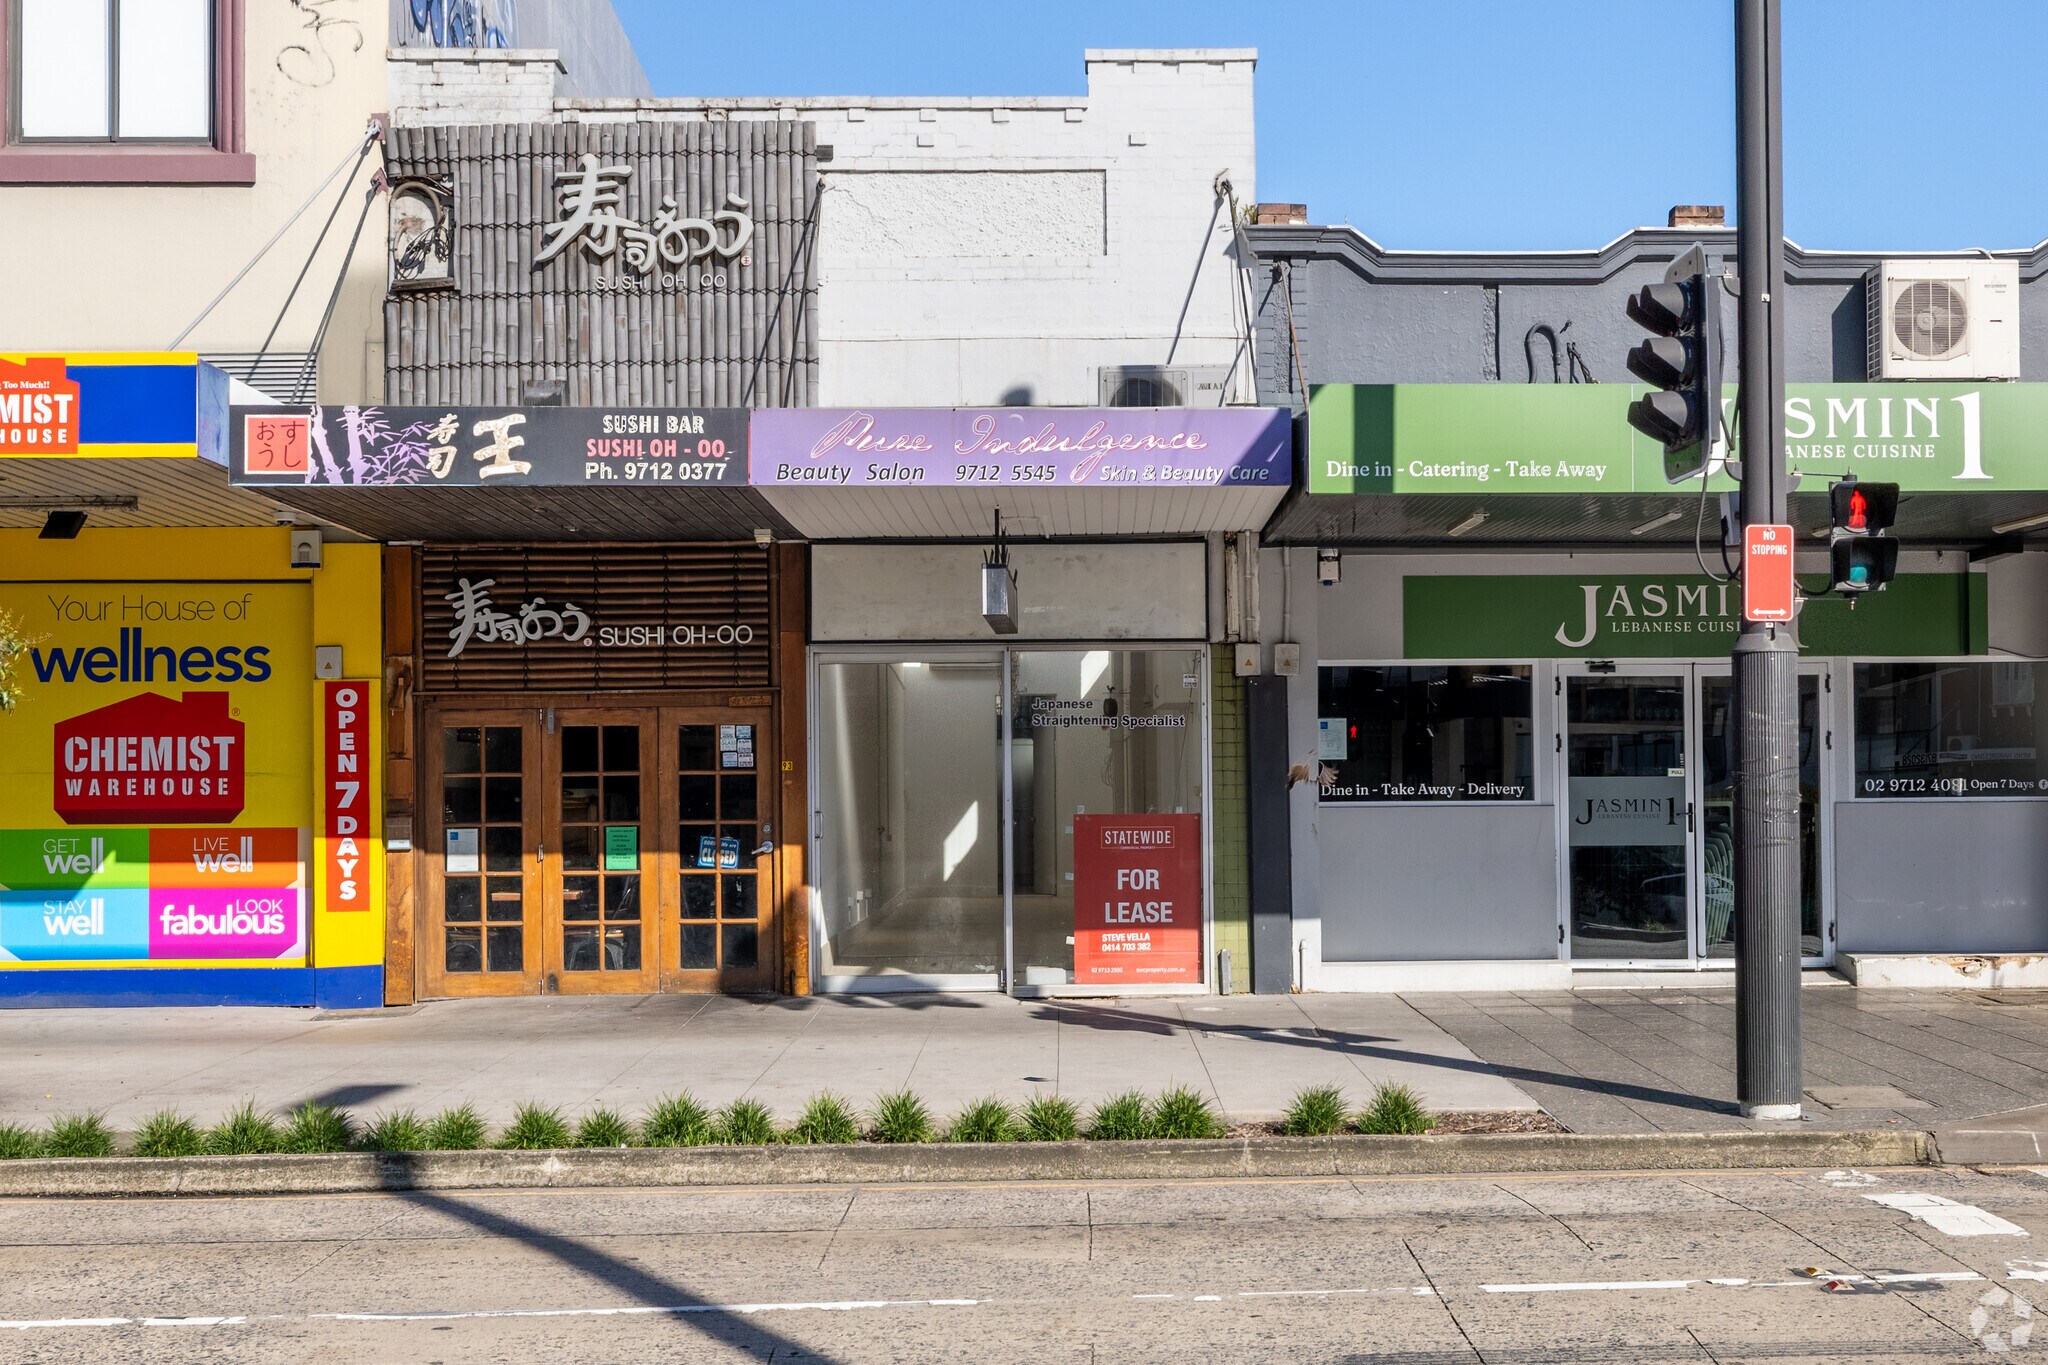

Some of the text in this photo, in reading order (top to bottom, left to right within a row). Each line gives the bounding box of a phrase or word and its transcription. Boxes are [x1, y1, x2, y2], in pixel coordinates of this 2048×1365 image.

[594, 275, 647, 290] SUSHI
[661, 274, 686, 288] OH
[3, 381, 18, 389] Too
[20, 381, 50, 389] Much!!
[602, 414, 704, 434] SUSHI BAR
[586, 439, 643, 457] SUSHI
[650, 439, 677, 457] OH
[810, 410, 1208, 484] Pure Indulgence
[1785, 444, 1935, 459] ANESE CUISINE
[585, 462, 727, 480] Ph. 9712 0377
[776, 462, 1269, 485] Beauty Salon 9712 5545 Skin & Beauty Care
[1326, 461, 1370, 478] Dine
[1374, 461, 1392, 477] in
[1409, 460, 1490, 481] Catering
[1505, 460, 1552, 478] Take
[1556, 460, 1607, 481] Away
[1762, 530, 1776, 541] NO
[1752, 544, 1788, 555] STOPPING
[47, 592, 253, 621] Your House of
[1554, 584, 1742, 648] JASMI
[599, 626, 664, 646] SUSHI
[672, 625, 753, 645] OH-OO
[1612, 621, 1741, 633] LEBANESE CUISI
[31, 627, 272, 682] wellness
[1032, 698, 1093, 711] Japanese
[1032, 714, 1186, 729] Straightening Specialist
[64, 736, 236, 773] CHEMIST
[65, 777, 230, 796] WAREHOUSE
[335, 688, 360, 900] OPEN 7 DAYS
[1321, 784, 1353, 796] Dine
[1355, 784, 1369, 795] in
[1381, 783, 1415, 796] Take
[1417, 783, 1456, 798] Away
[1467, 782, 1525, 798] Delivery
[1865, 778, 2035, 792] 02 9712 4081 Open 7 Days
[43, 838, 80, 853] GET
[193, 837, 229, 851] LIVE
[1104, 830, 1171, 845] STATEWIDE
[43, 837, 104, 874] well
[193, 836, 253, 873] well
[1117, 868, 1160, 891] FOR
[43, 900, 87, 914] STAY
[236, 898, 283, 914] LOOK
[1104, 902, 1173, 924] LEASE
[43, 898, 104, 936] well
[160, 904, 286, 936] fabulous
[1101, 932, 1150, 942] STEVE VELLA
[1101, 943, 1121, 952] 0414
[1121, 943, 1136, 951] 703
